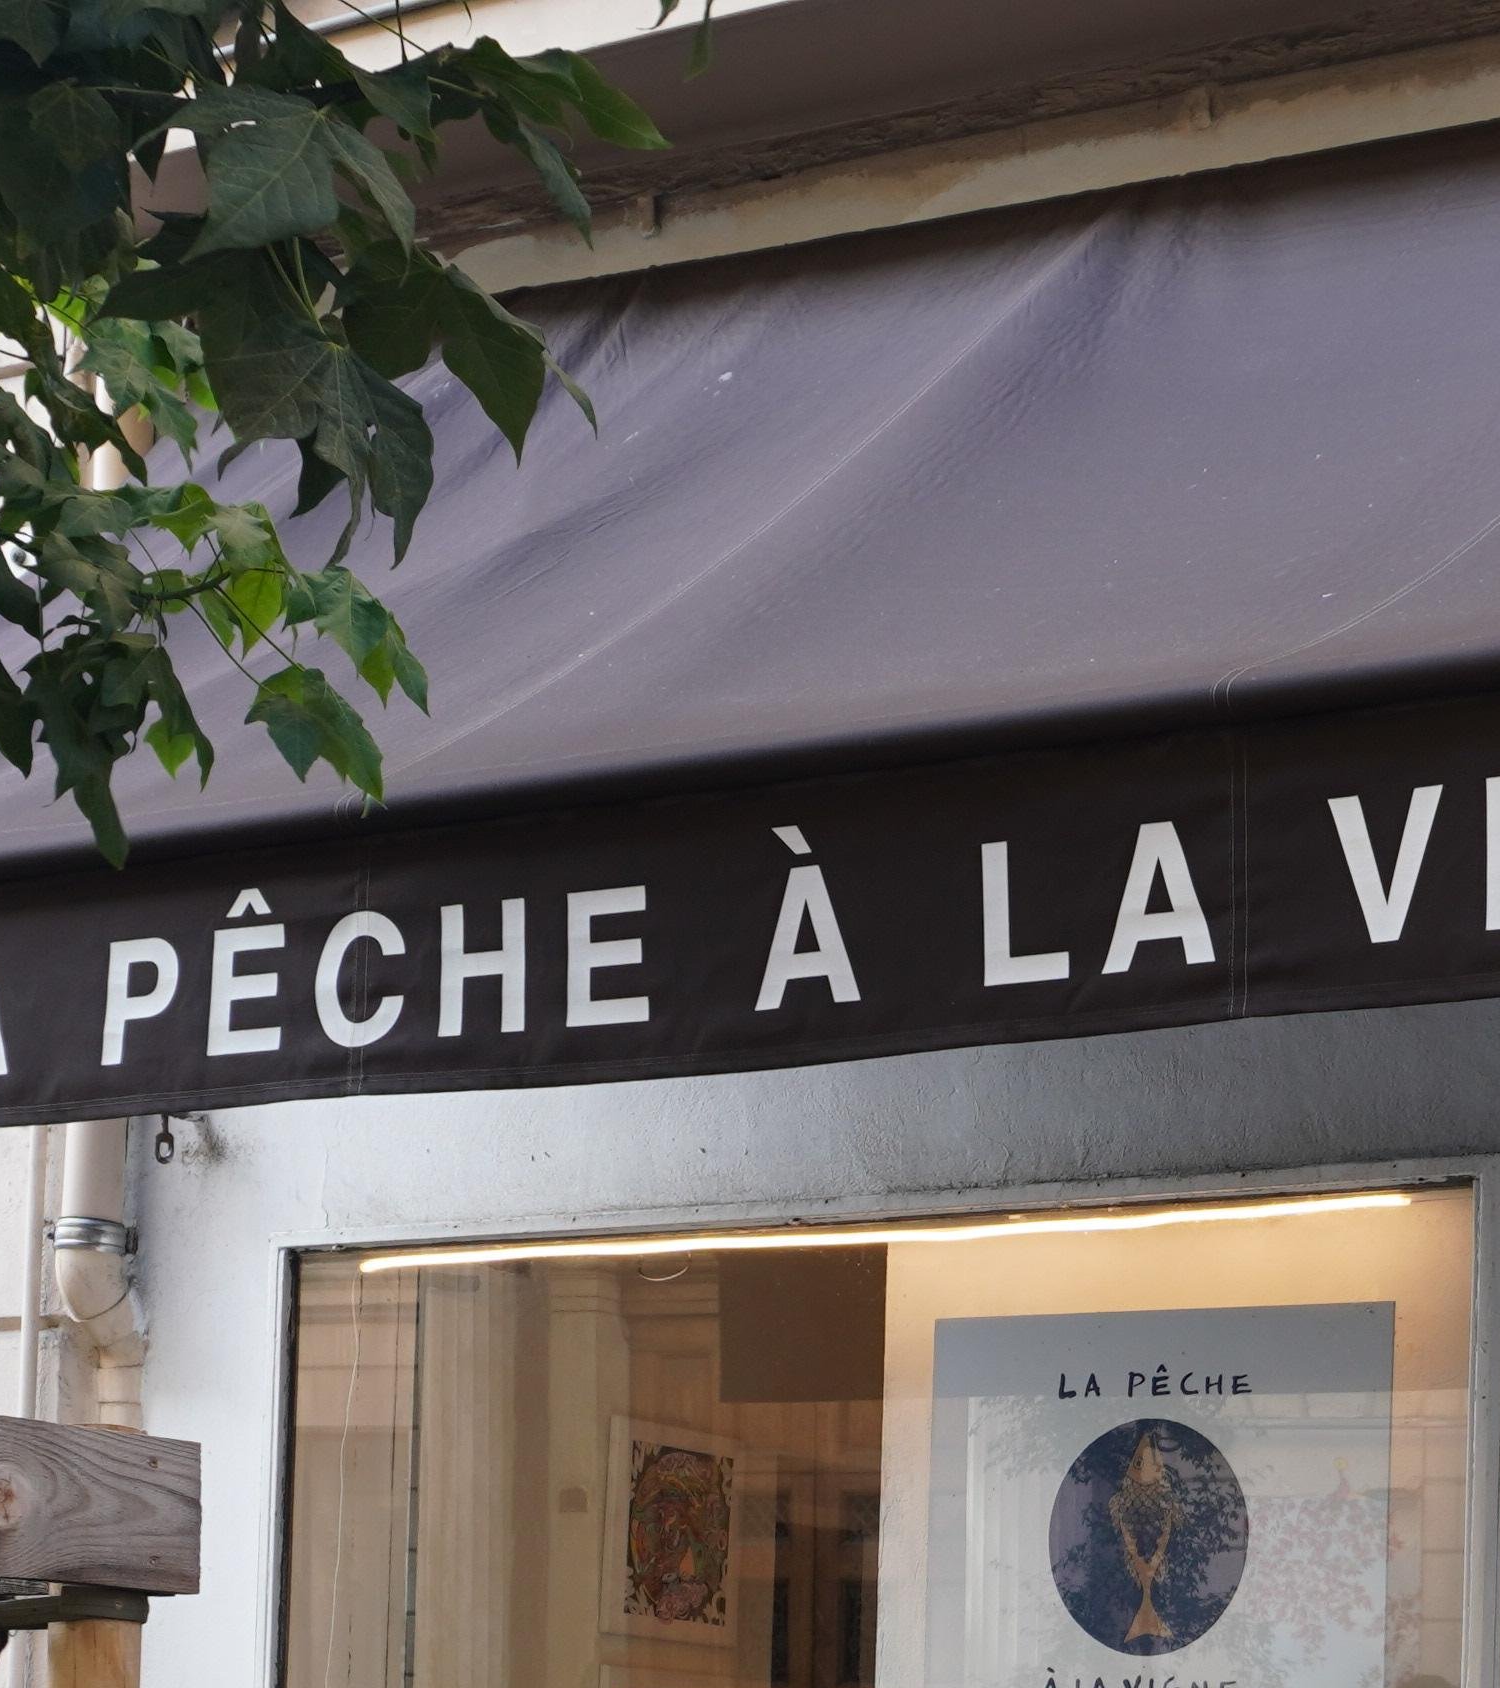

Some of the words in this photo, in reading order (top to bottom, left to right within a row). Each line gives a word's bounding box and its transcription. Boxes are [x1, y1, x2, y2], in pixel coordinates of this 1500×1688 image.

[100, 886, 651, 1066] PÊCHE
[754, 825, 862, 1011] À
[982, 820, 1217, 987] LA
[1058, 1372, 1101, 1399] LA
[1127, 1364, 1254, 1397] PÊCHE
